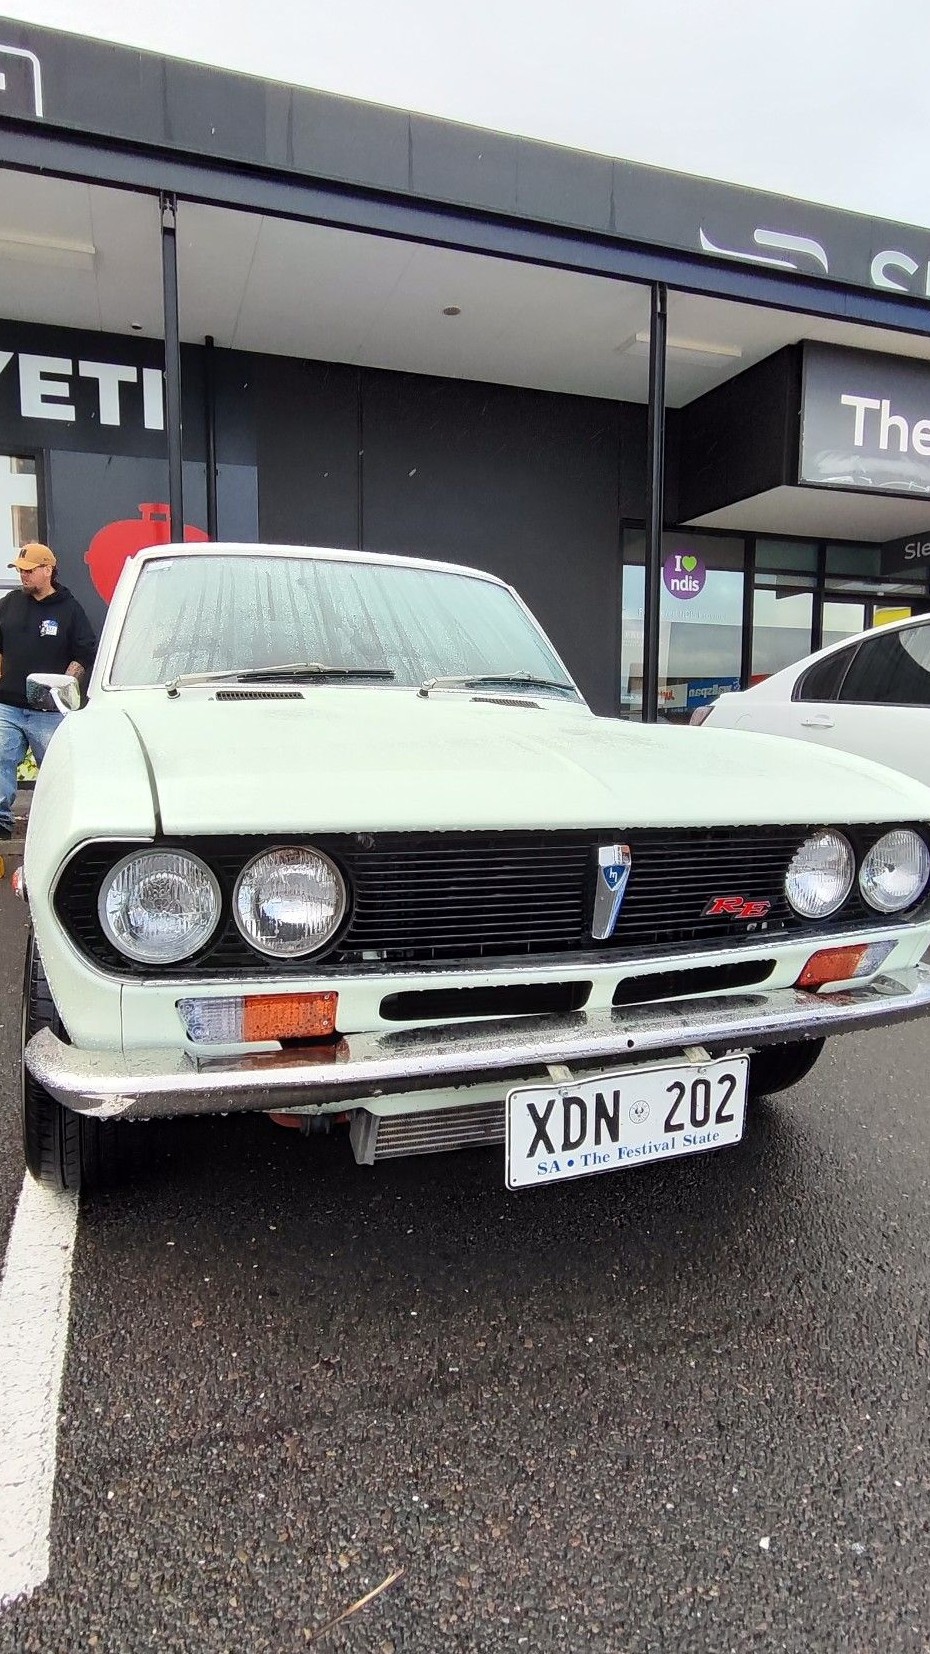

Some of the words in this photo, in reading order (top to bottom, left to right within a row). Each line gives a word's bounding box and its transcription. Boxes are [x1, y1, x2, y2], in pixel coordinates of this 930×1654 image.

[841, 394, 930, 456] The
[904, 542, 930, 560] Sle
[674, 555, 682, 572] I
[670, 576, 700, 592] ndis
[705, 896, 771, 919] RE
[525, 1089, 621, 1159] XDN
[663, 1073, 737, 1133] 202
[537, 1160, 561, 1176] SA
[580, 1151, 611, 1168] The
[617, 1137, 676, 1160] Festival
[682, 1130, 720, 1147] State
